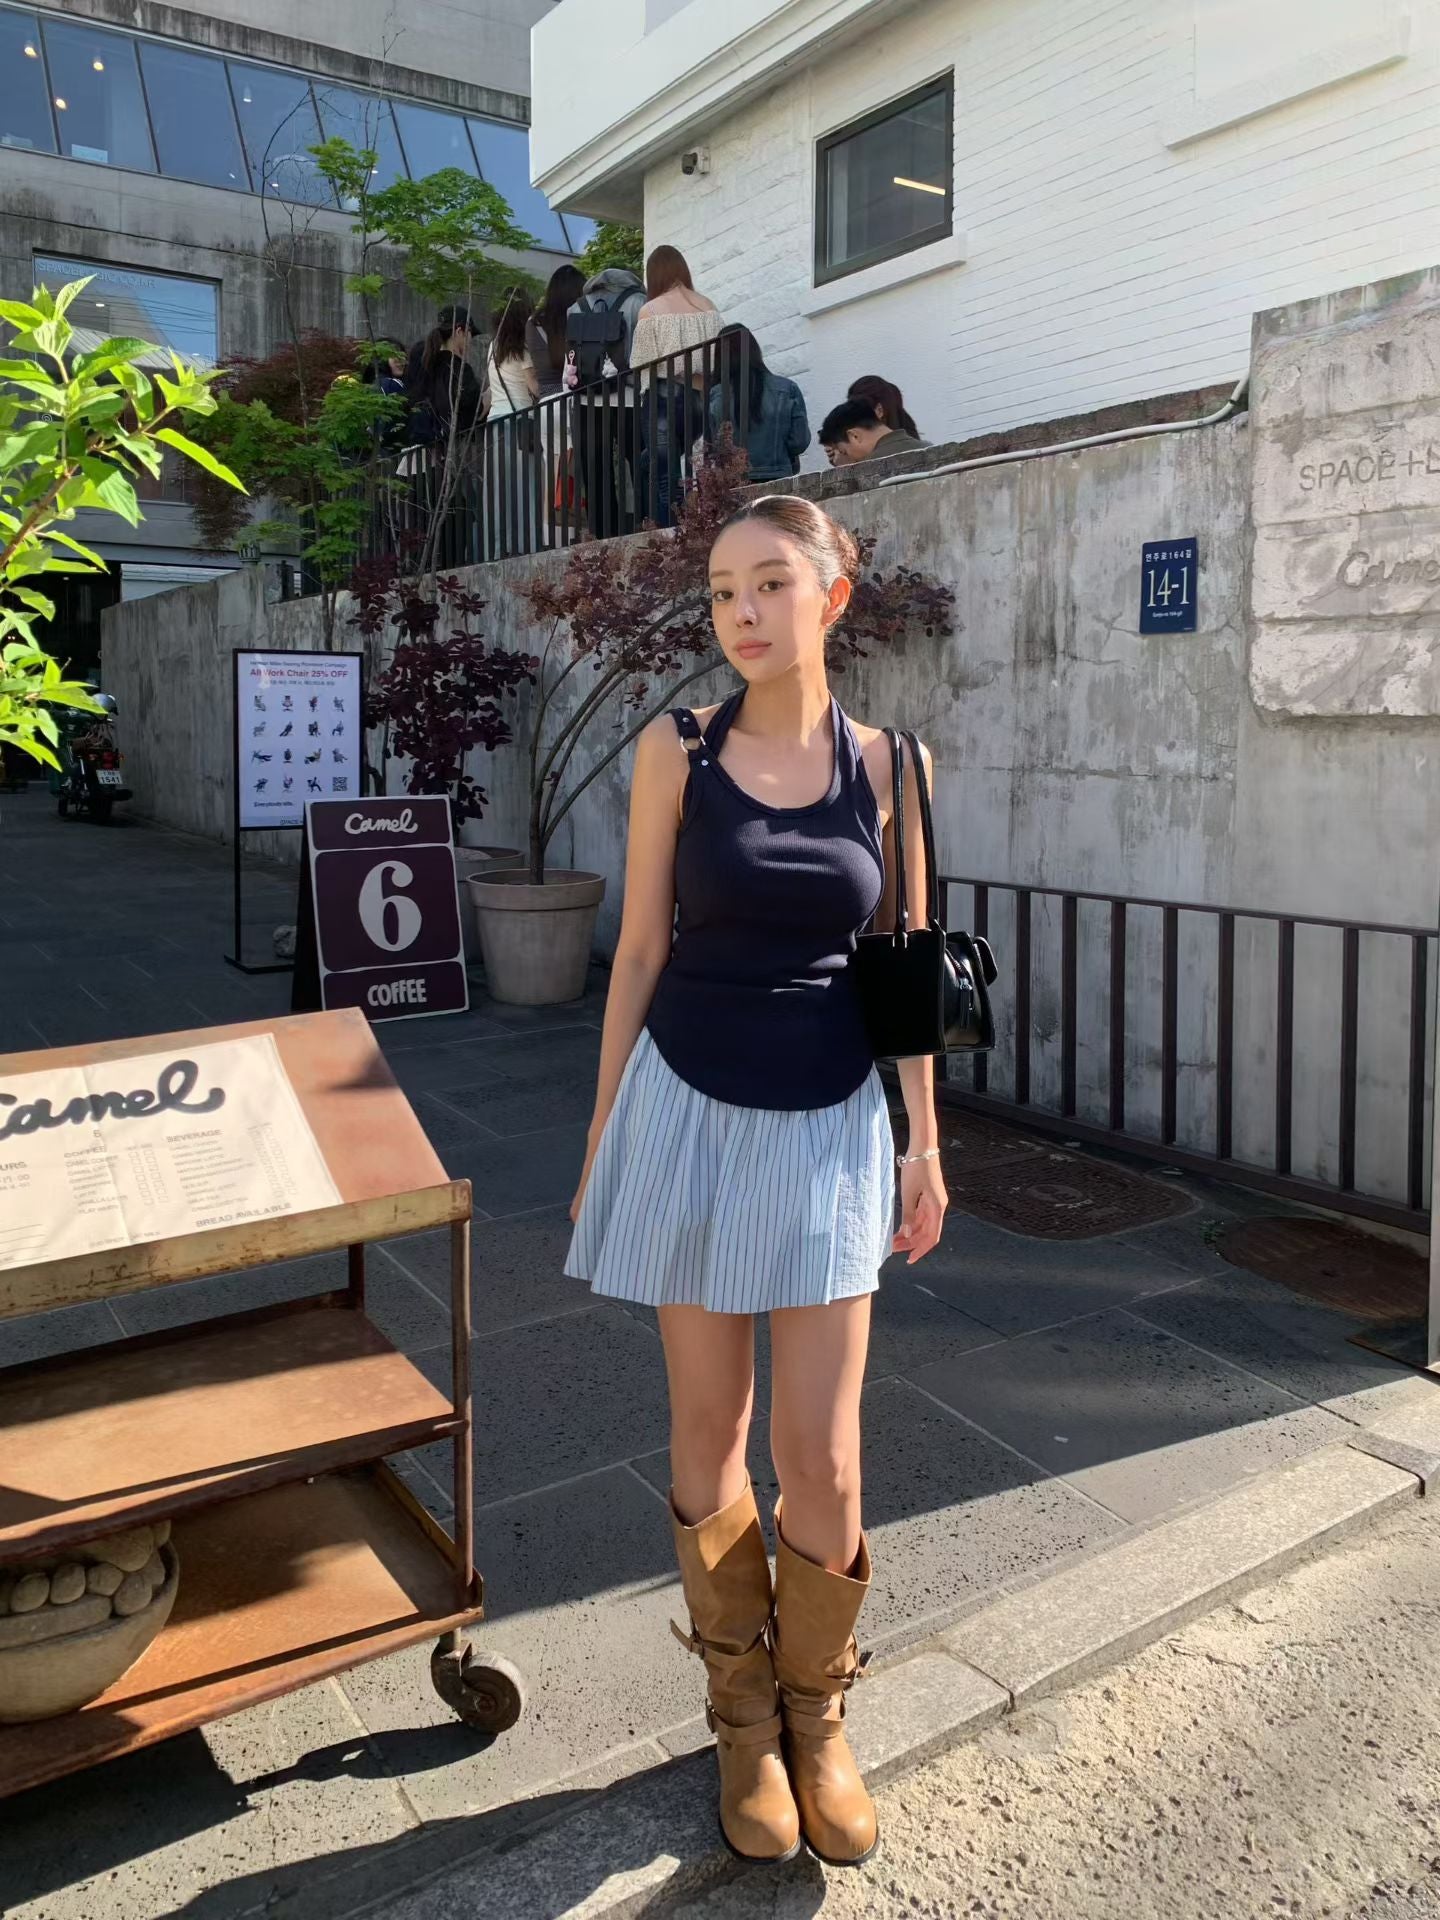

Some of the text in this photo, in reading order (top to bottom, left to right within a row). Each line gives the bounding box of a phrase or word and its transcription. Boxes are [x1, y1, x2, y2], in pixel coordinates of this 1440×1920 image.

[1147, 566, 1190, 607] 14-1
[287, 669, 309, 677] Chair
[311, 670, 329, 678] 25%
[331, 670, 349, 678] OFF
[344, 808, 418, 834] Camel
[358, 860, 423, 952] 6
[367, 978, 427, 1007] COFFEE
[0, 1059, 226, 1141] amel
[167, 1129, 223, 1143] BEVERAGE
[196, 1213, 233, 1228] BREAD
[235, 1202, 292, 1218] AVAILABLE
